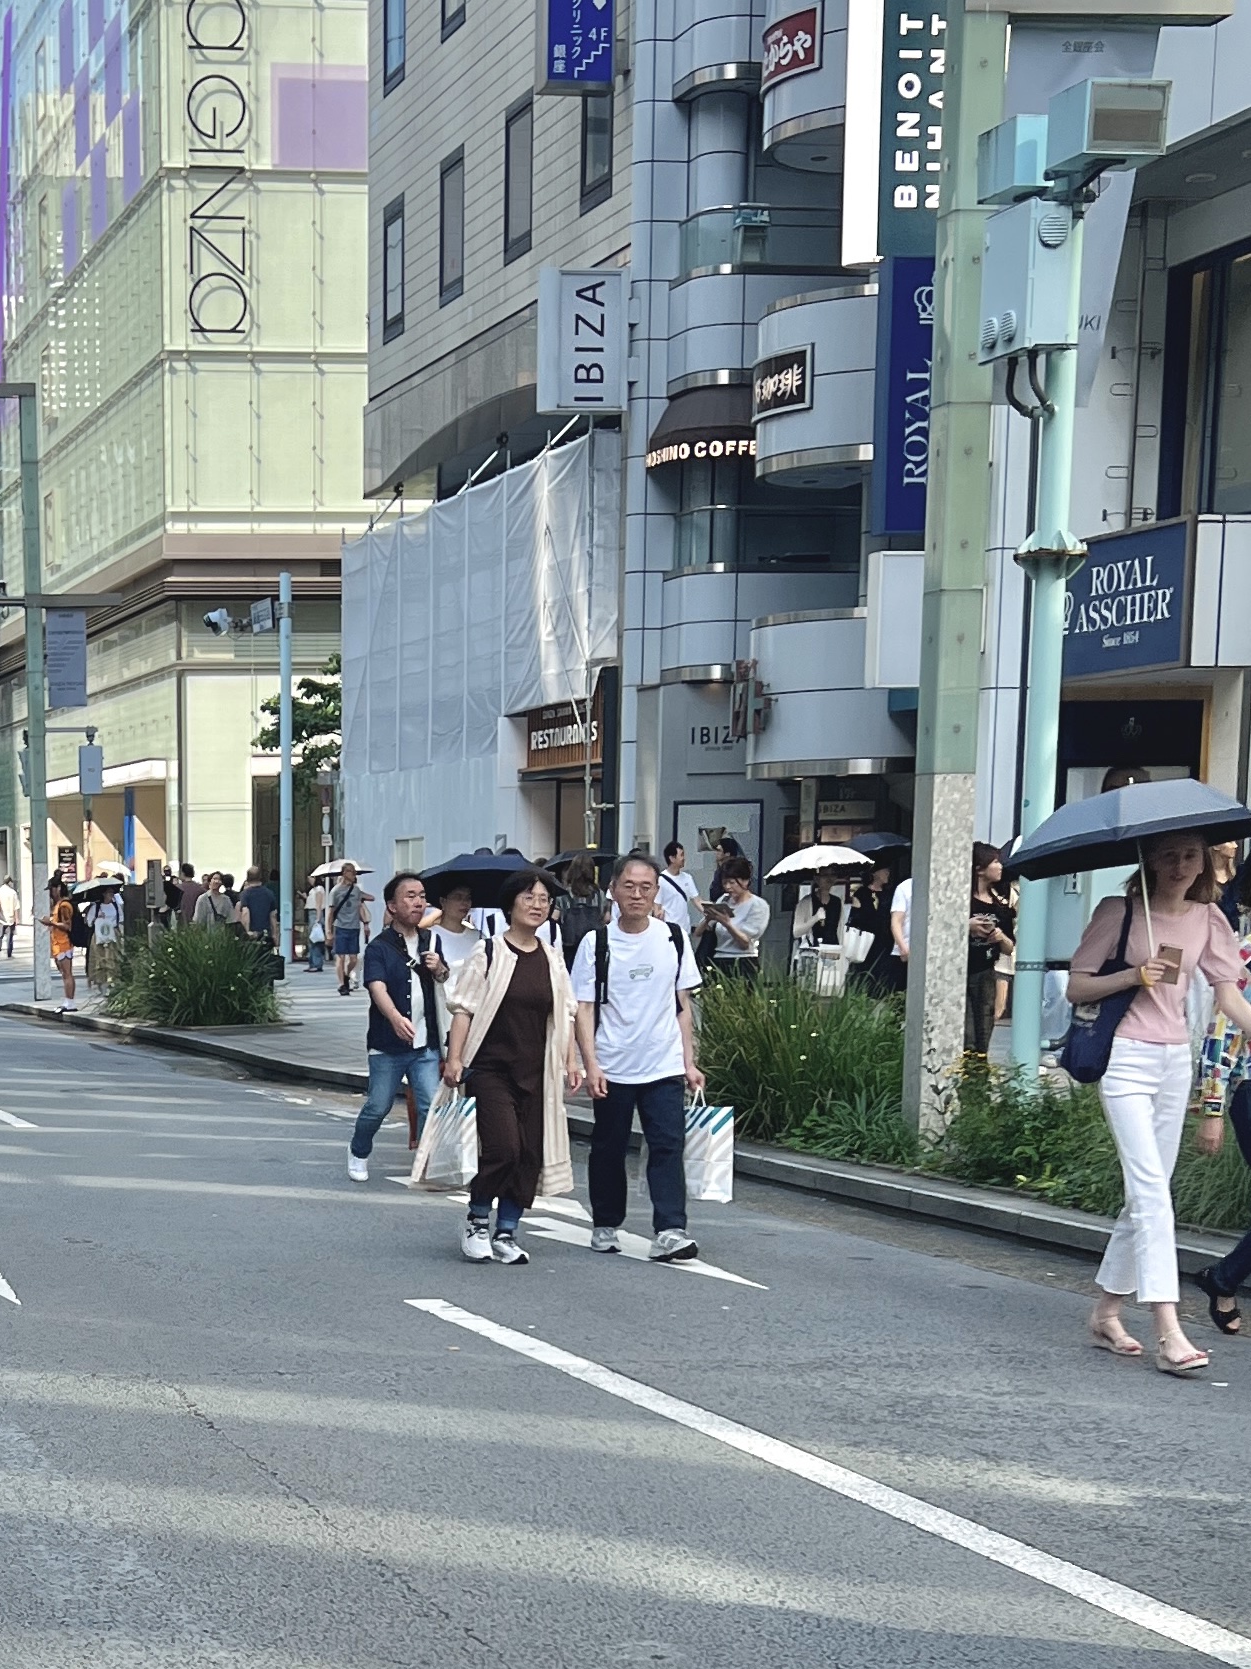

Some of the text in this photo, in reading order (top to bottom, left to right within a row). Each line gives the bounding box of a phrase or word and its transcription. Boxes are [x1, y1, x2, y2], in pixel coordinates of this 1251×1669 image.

[588, 27, 609, 41] 4F
[553, 44, 566, 73] 銀座
[894, 13, 924, 209] BENOIT
[574, 280, 606, 403] IBIZA
[1090, 555, 1160, 597] ROYAL
